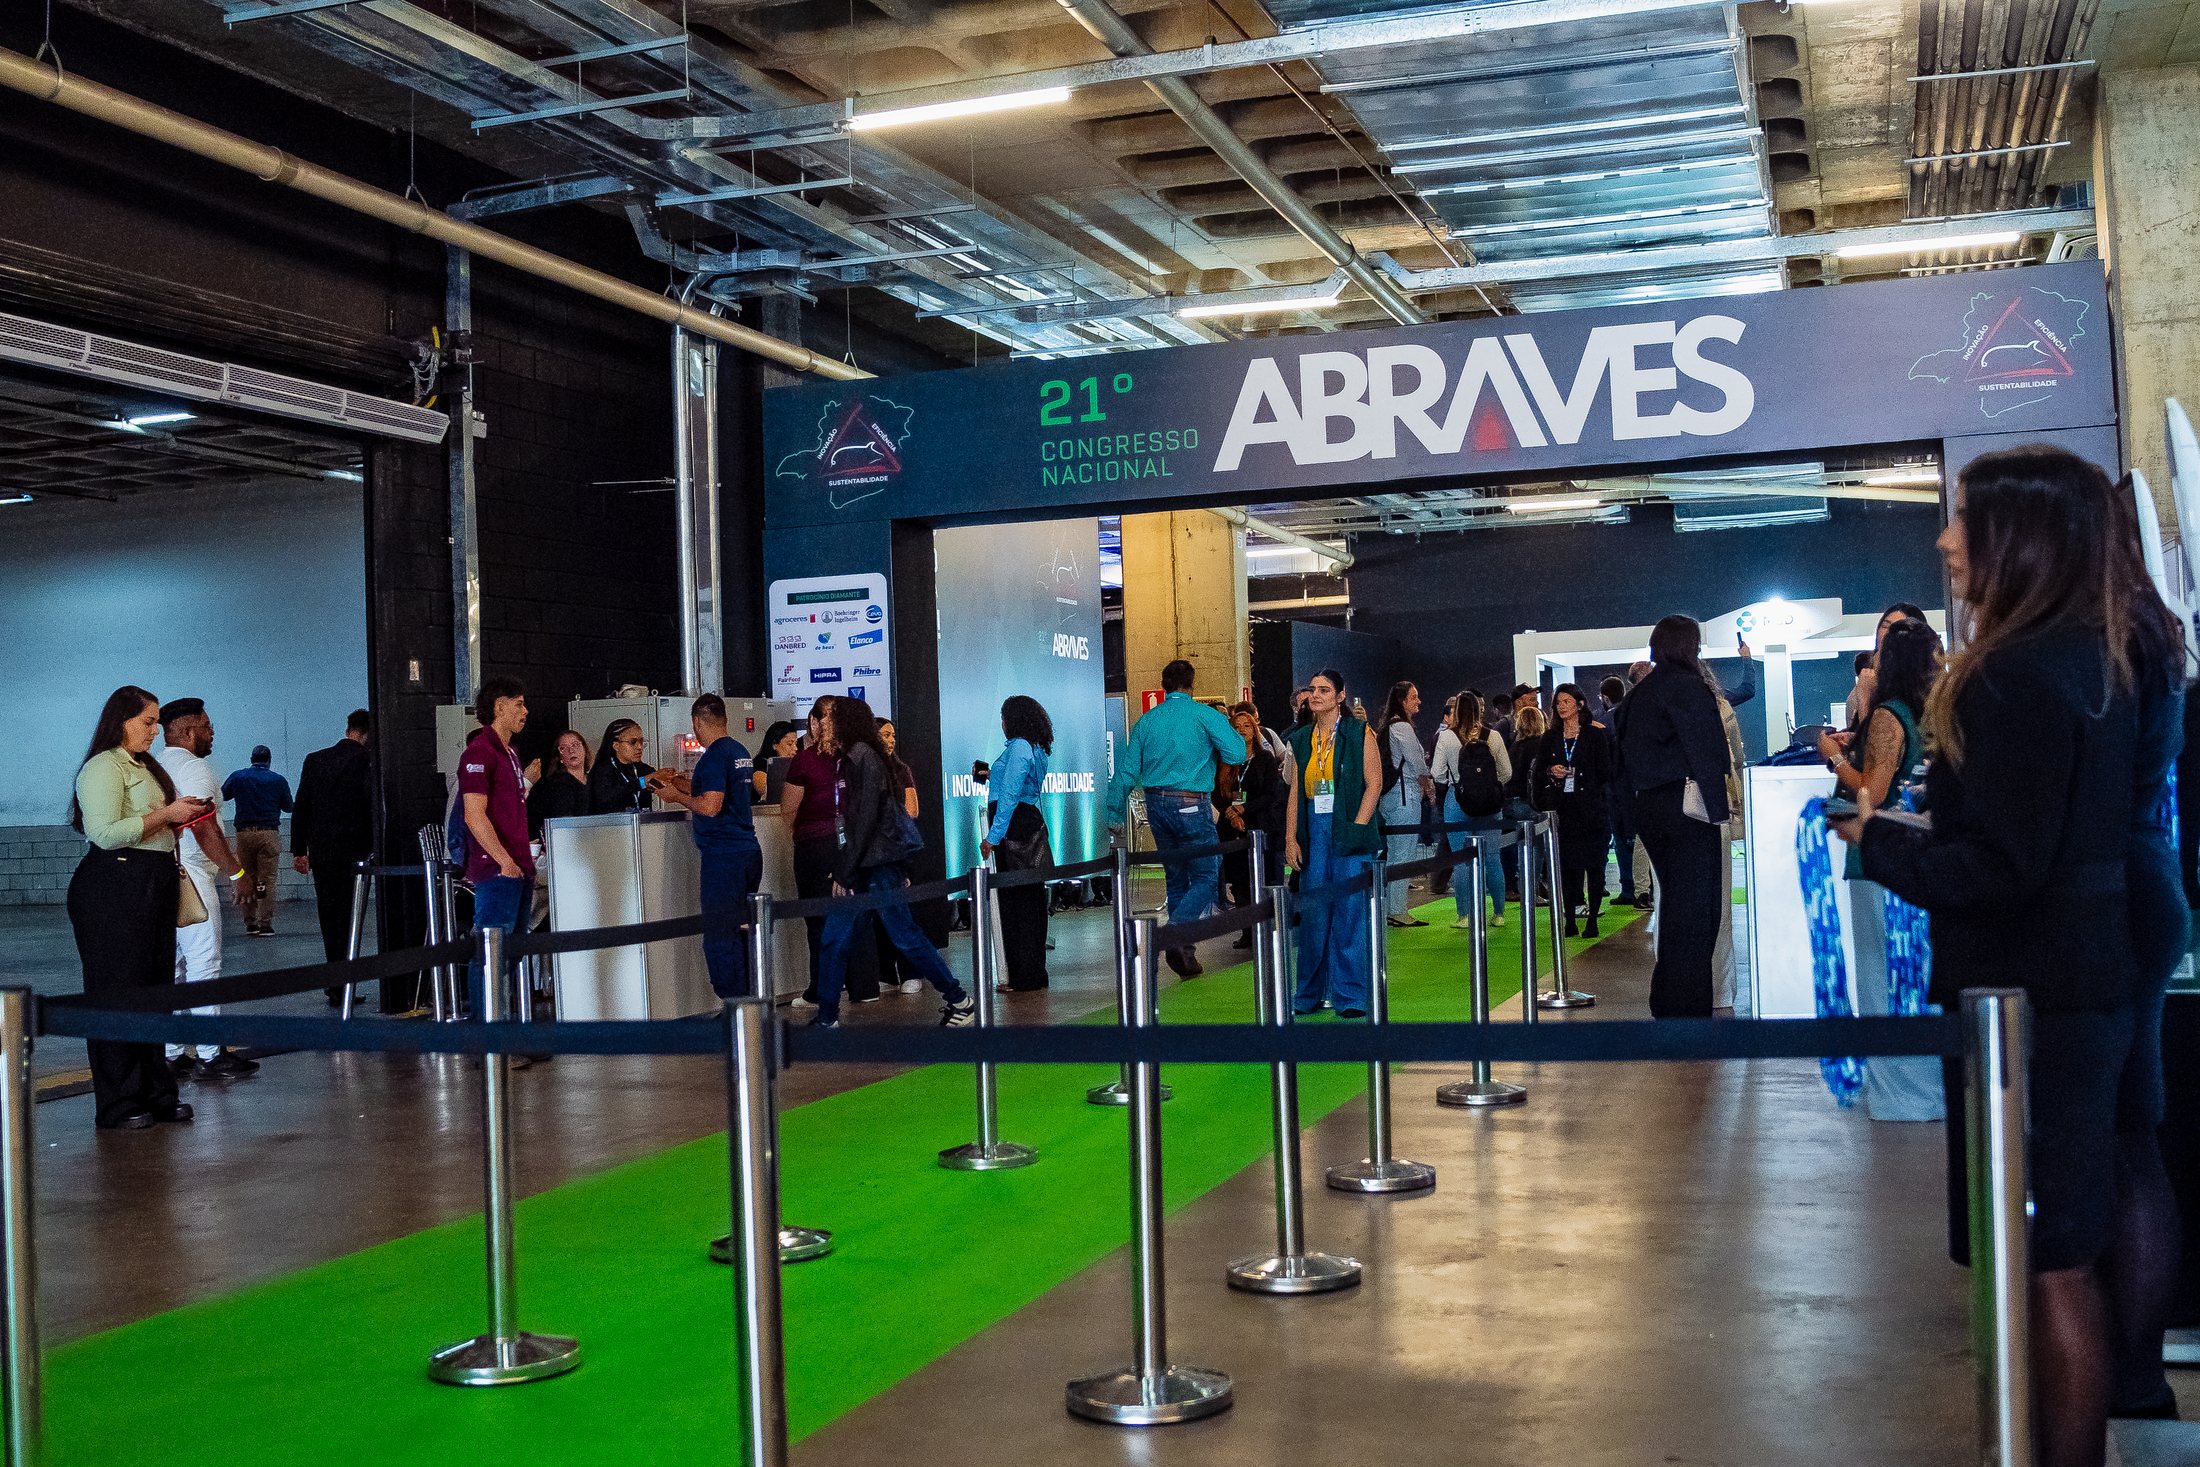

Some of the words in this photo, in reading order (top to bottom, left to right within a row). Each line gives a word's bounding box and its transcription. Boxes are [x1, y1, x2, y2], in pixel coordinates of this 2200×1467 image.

[1962, 324, 1989, 362] INOVAÇÃO
[2033, 318, 2067, 353] EFICIÊNCIA
[1212, 314, 1755, 473] ABRAVES
[1978, 379, 2058, 392] SUSTENTABILIDADE
[817, 428, 838, 460] INOVAÇÃO
[871, 423, 897, 453] EFICIÊNCIA
[1041, 428, 1199, 462] CONGRESSO
[828, 475, 889, 487] SUSTENTABILIDADE
[1042, 457, 1174, 487] NACIONAL
[831, 591, 860, 599] DIAMANTE
[774, 616, 807, 625] agroceres
[775, 642, 806, 650] DANBRED
[850, 636, 874, 644] Elanco
[1052, 632, 1089, 661] ABRAVES
